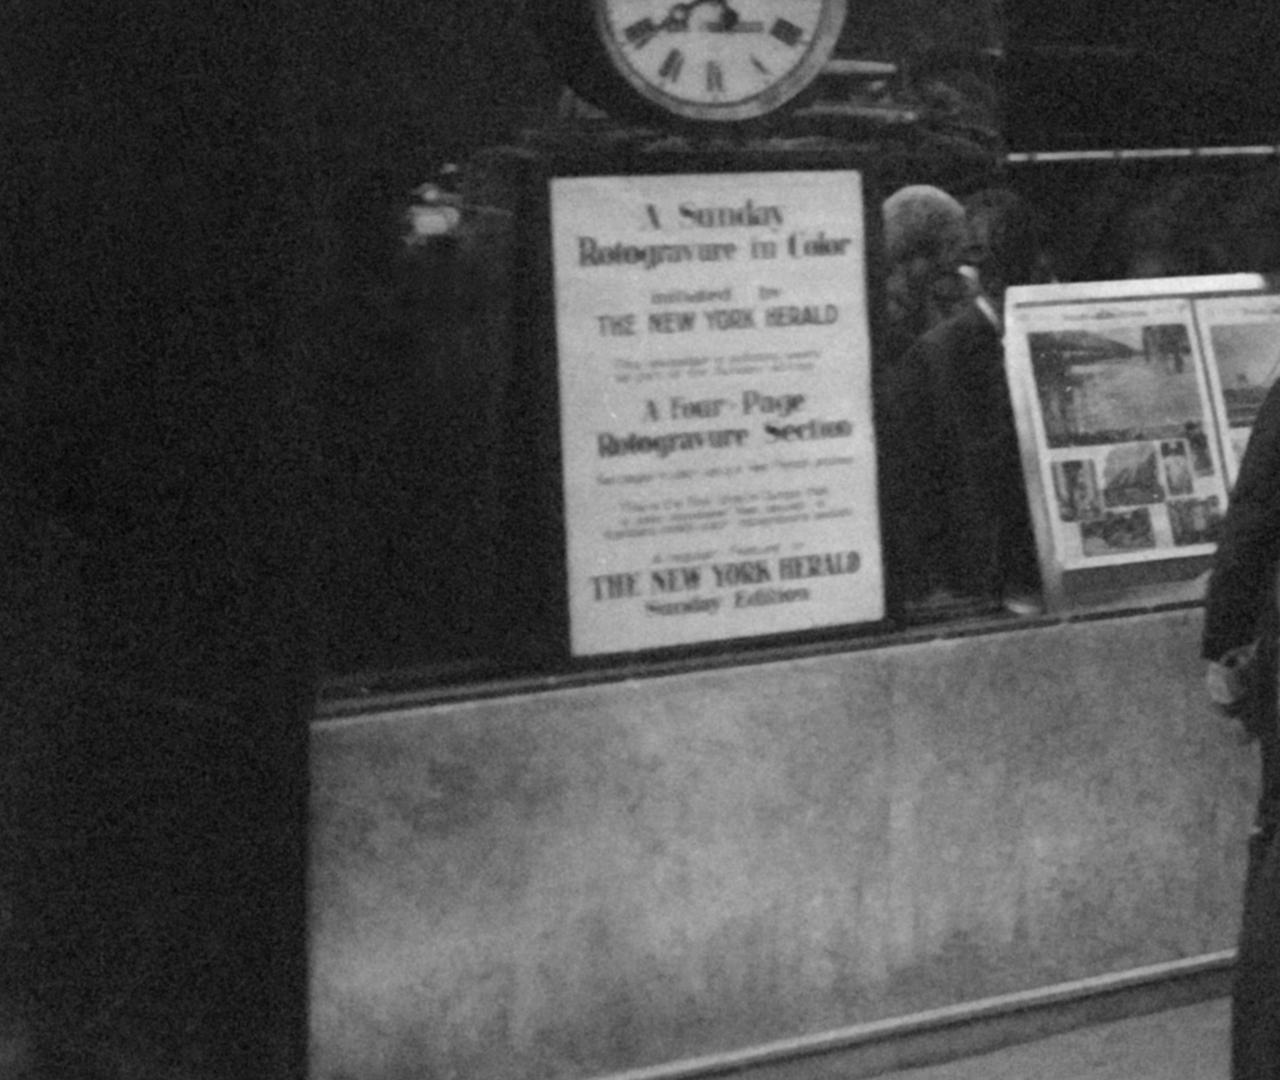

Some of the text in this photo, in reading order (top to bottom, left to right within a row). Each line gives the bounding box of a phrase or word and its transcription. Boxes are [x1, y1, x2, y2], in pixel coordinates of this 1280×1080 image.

[643, 198, 784, 235] A Sunday
[578, 231, 851, 270] Rotogravure in Color
[598, 303, 838, 336] THE NEW YORK HERALD
[643, 399, 659, 422] A
[597, 419, 853, 458] Rotogravure Section
[590, 550, 862, 602] THE NEW YORK HERALD
[645, 587, 811, 616] Sunday Edition
